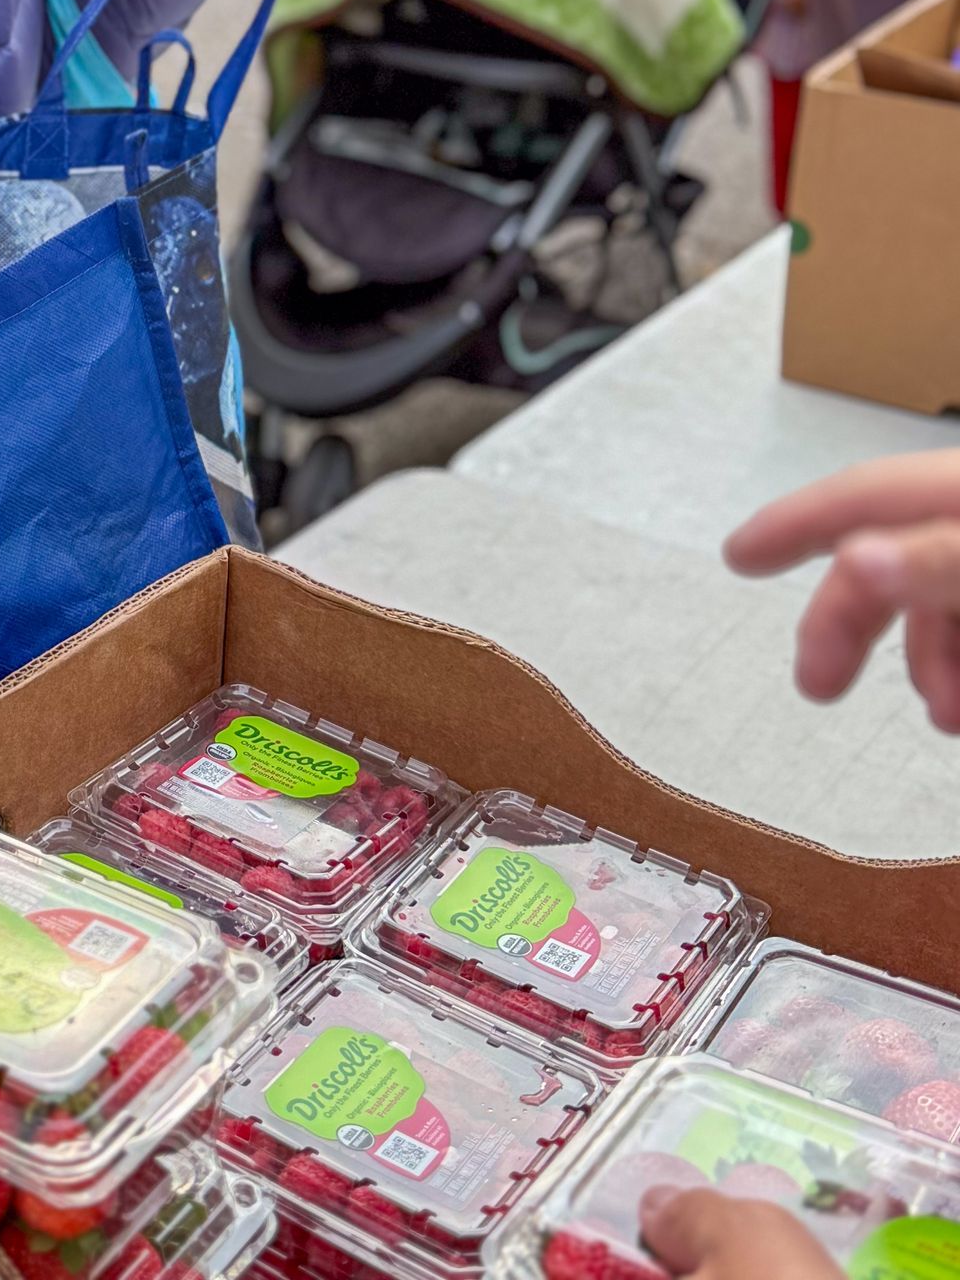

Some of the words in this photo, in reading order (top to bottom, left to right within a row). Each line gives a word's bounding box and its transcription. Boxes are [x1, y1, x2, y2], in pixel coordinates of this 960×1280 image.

[235, 723, 348, 781] Driscoll's
[241, 740, 258, 750] Only
[272, 755, 296, 768] Finest
[297, 766, 323, 780] Berries
[243, 751, 270, 766] Organic
[252, 762, 297, 784] Raspberries
[450, 856, 531, 933] Driscoll's
[484, 916, 499, 929] Only
[495, 909, 506, 918] the
[515, 876, 534, 893] Berries
[286, 1037, 378, 1121] Driscoll's
[324, 1104, 341, 1118] Only
[337, 1095, 349, 1105] the
[344, 1078, 363, 1096] Finest
[360, 1059, 381, 1079] Berries
